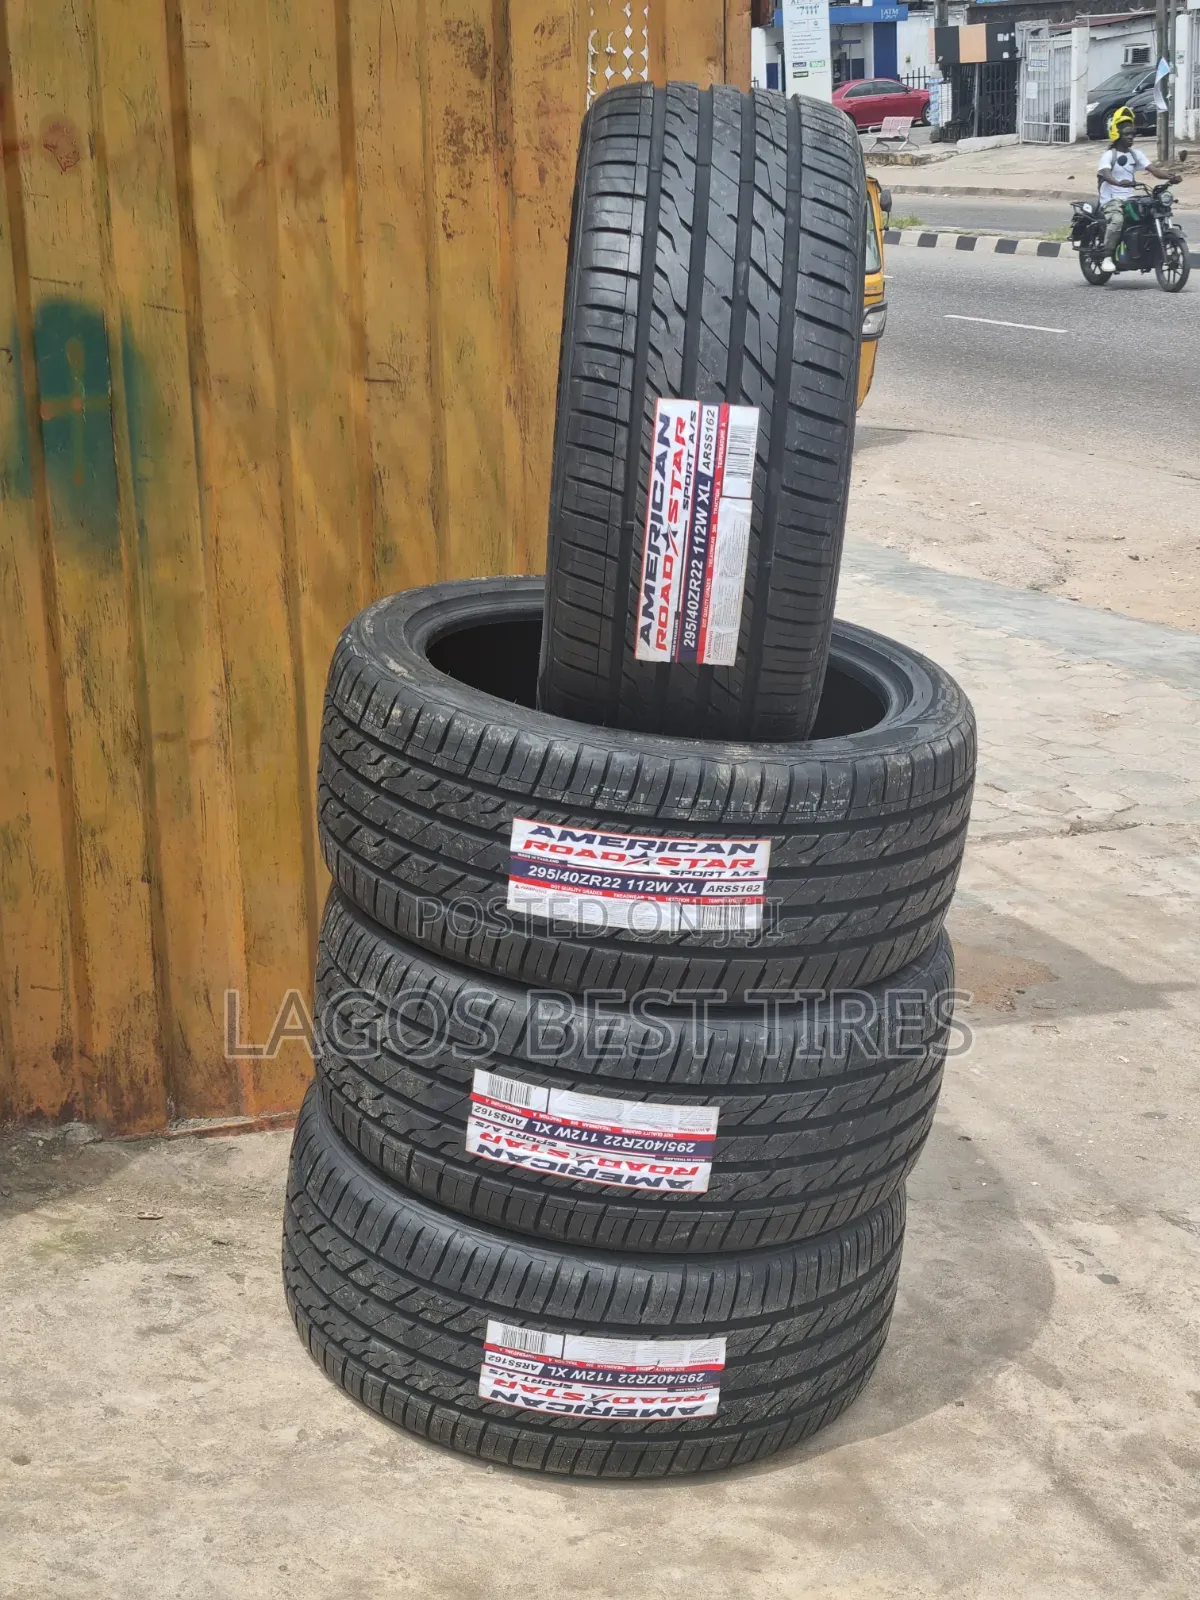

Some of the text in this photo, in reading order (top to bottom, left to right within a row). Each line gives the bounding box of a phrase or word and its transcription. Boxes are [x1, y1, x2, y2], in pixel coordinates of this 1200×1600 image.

[702, 409, 715, 471] ARSS162
[683, 410, 697, 511] SPORT A/S
[640, 413, 671, 648] AMERICAN
[656, 416, 686, 651] ROAD STAR
[684, 480, 711, 648] 295/40ZR22 112W XL
[523, 840, 755, 869] ROAD STAR
[528, 825, 759, 856] AMERICAN
[528, 865, 697, 894] 295/40ZR22 112W XL
[669, 870, 726, 878] SPORT
[474, 1105, 523, 1126] ARSS162
[475, 1121, 557, 1147] SPORT A/S
[532, 1121, 696, 1153] 295/40ZR22 112W XL
[477, 1144, 693, 1189] AMERICAN
[480, 1132, 699, 1176] ROAD STAR
[488, 1354, 539, 1371] ARSS162
[547, 1366, 705, 1384] 295/40ZR22 112W XL
[488, 1368, 573, 1389] SPORT A/S
[493, 1378, 708, 1404] ROAD STAR
[490, 1390, 703, 1417] AMERICAN
